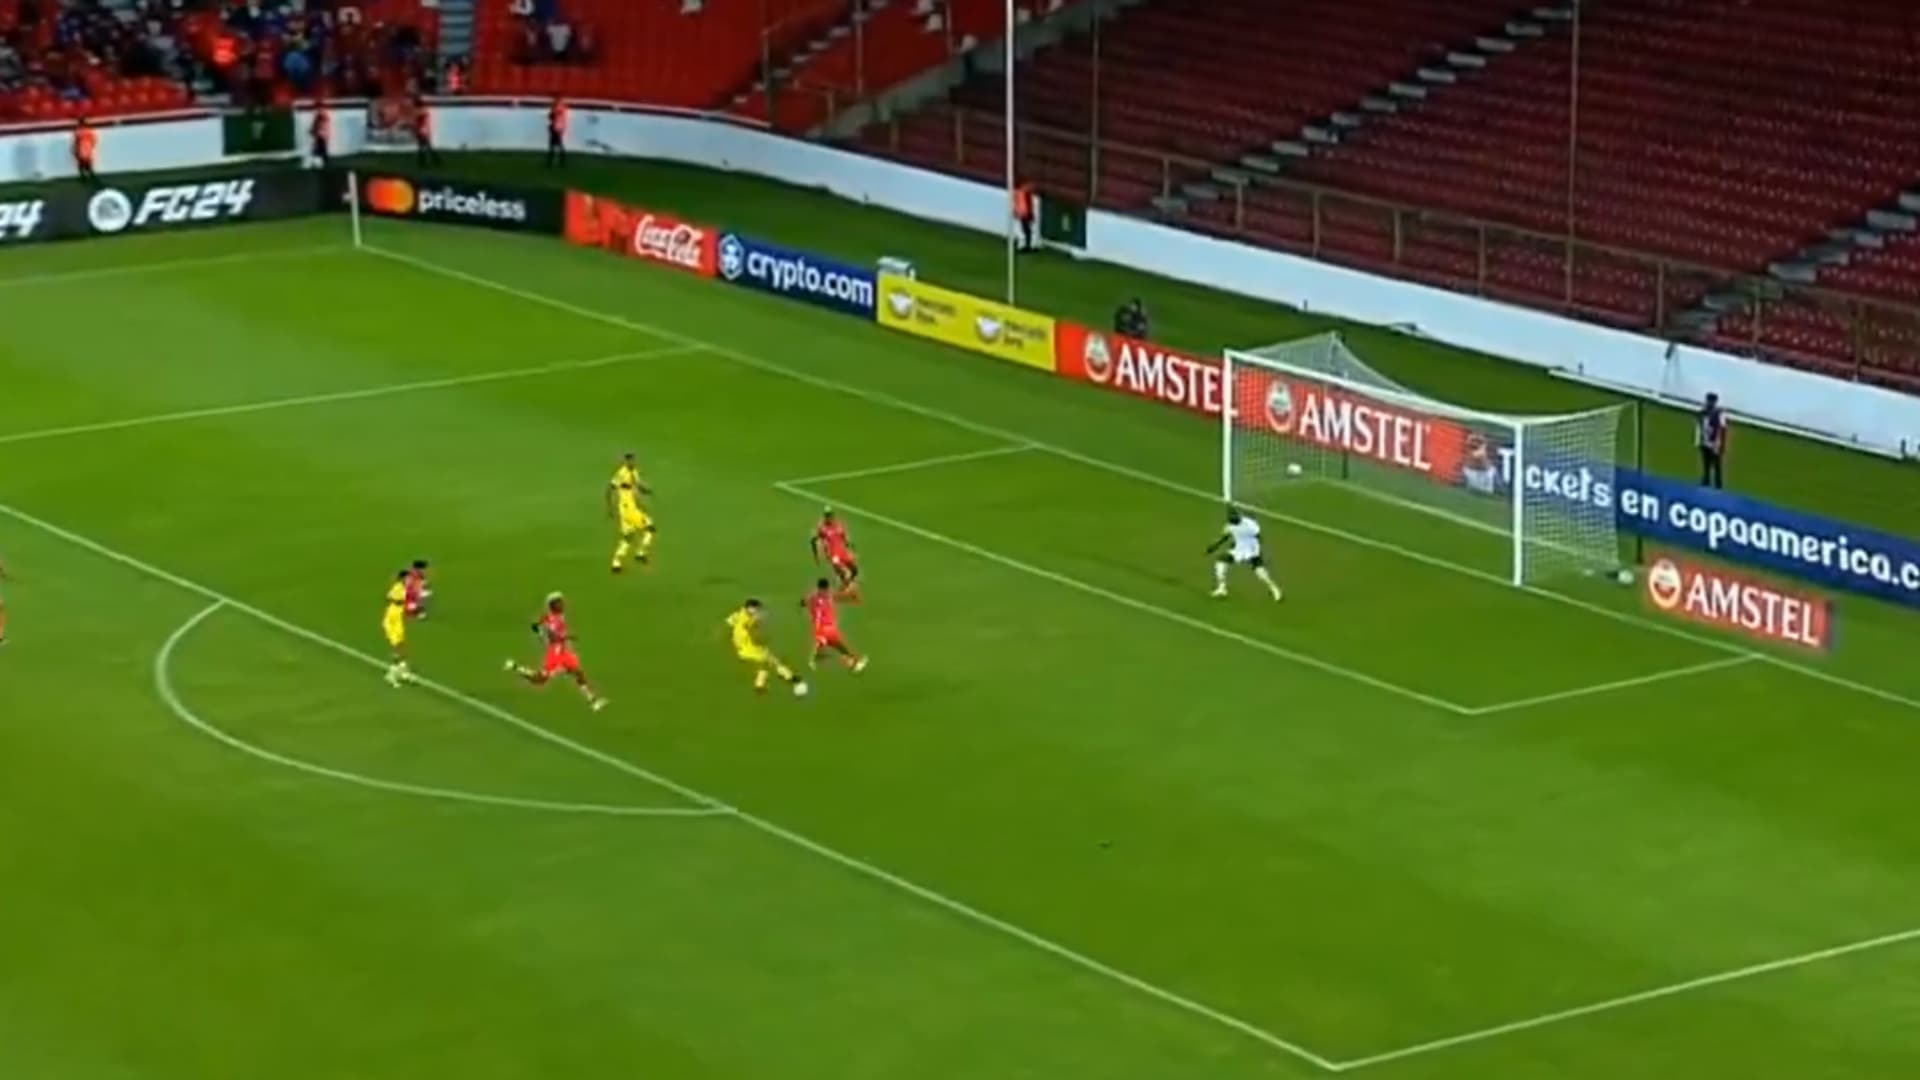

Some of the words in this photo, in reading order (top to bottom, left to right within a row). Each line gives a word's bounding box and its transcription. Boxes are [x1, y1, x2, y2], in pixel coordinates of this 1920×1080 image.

[418, 186, 526, 220] priceless
[747, 251, 873, 306] crypto.com
[1299, 392, 1432, 471] AMSTEL
[1496, 446, 1613, 508] Tckets
[1620, 488, 1660, 523] en
[1668, 501, 1920, 590] copaamerica.c
[1684, 572, 1820, 646] AMSTEL
